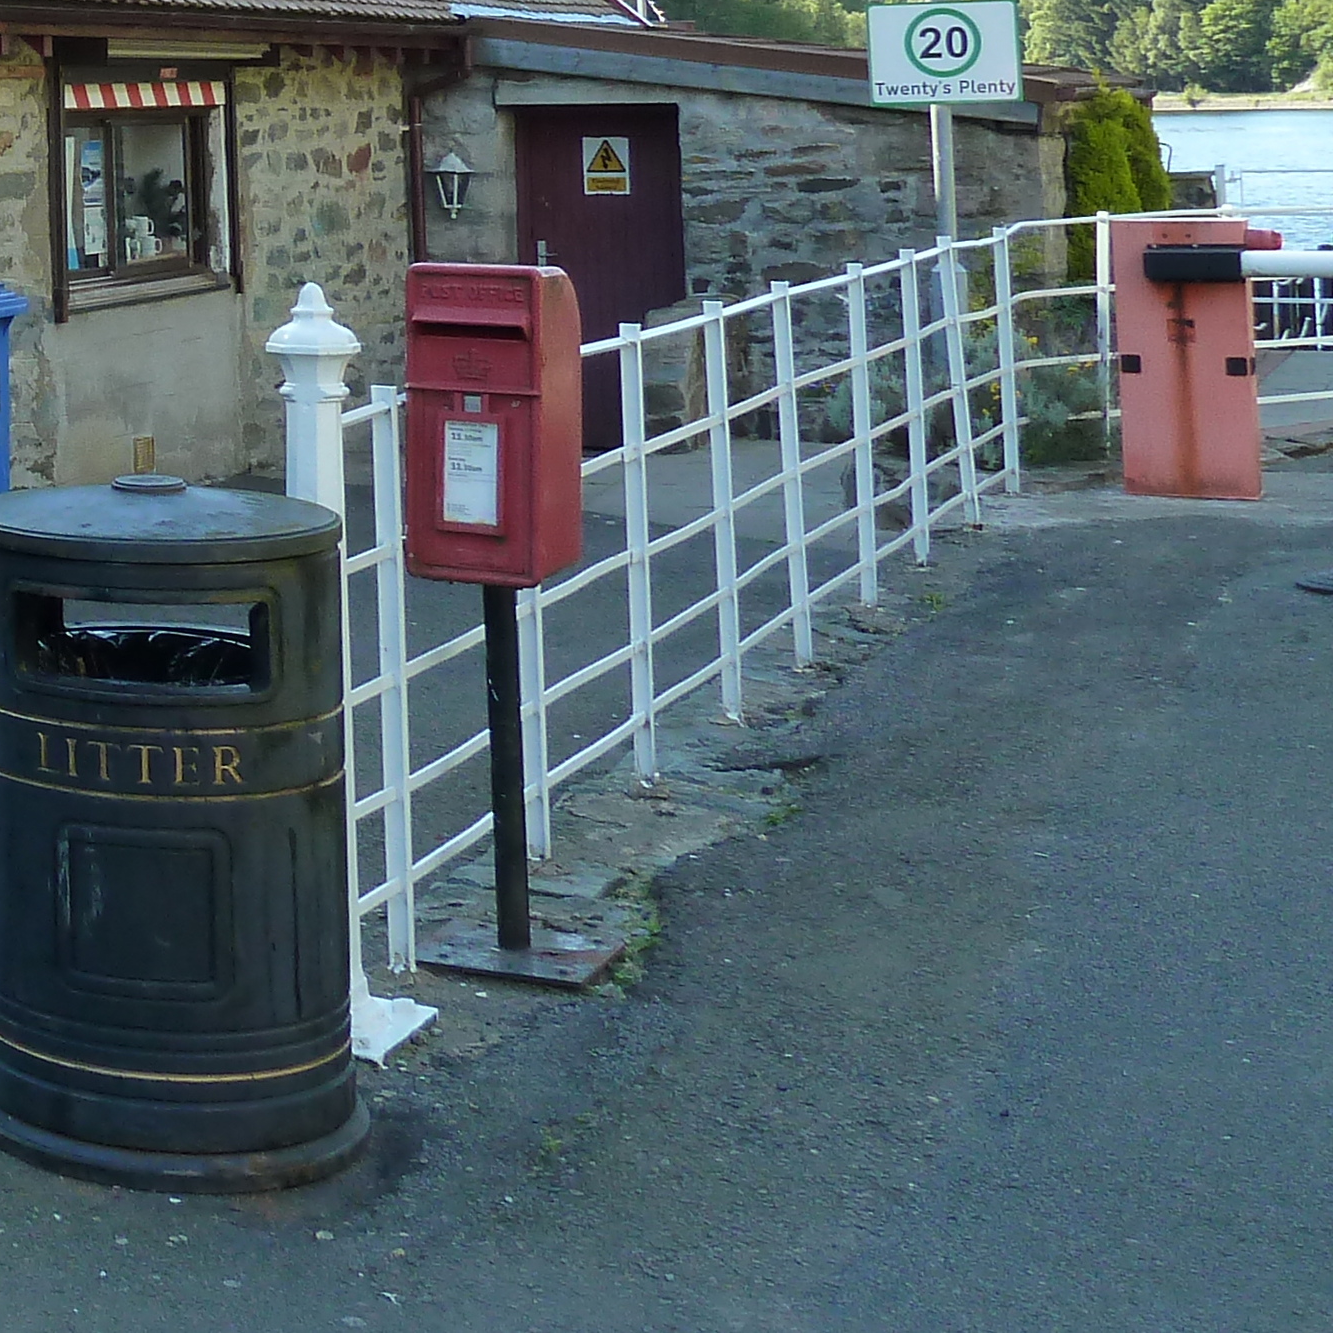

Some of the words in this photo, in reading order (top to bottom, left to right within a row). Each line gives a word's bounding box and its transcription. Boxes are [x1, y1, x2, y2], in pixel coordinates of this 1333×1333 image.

[918, 26, 969, 59] 20
[875, 79, 952, 97] Twenty's
[959, 77, 1017, 97] Plenty
[420, 282, 463, 301] POST
[468, 283, 525, 304] OFFICE
[36, 730, 245, 787] LITTER
